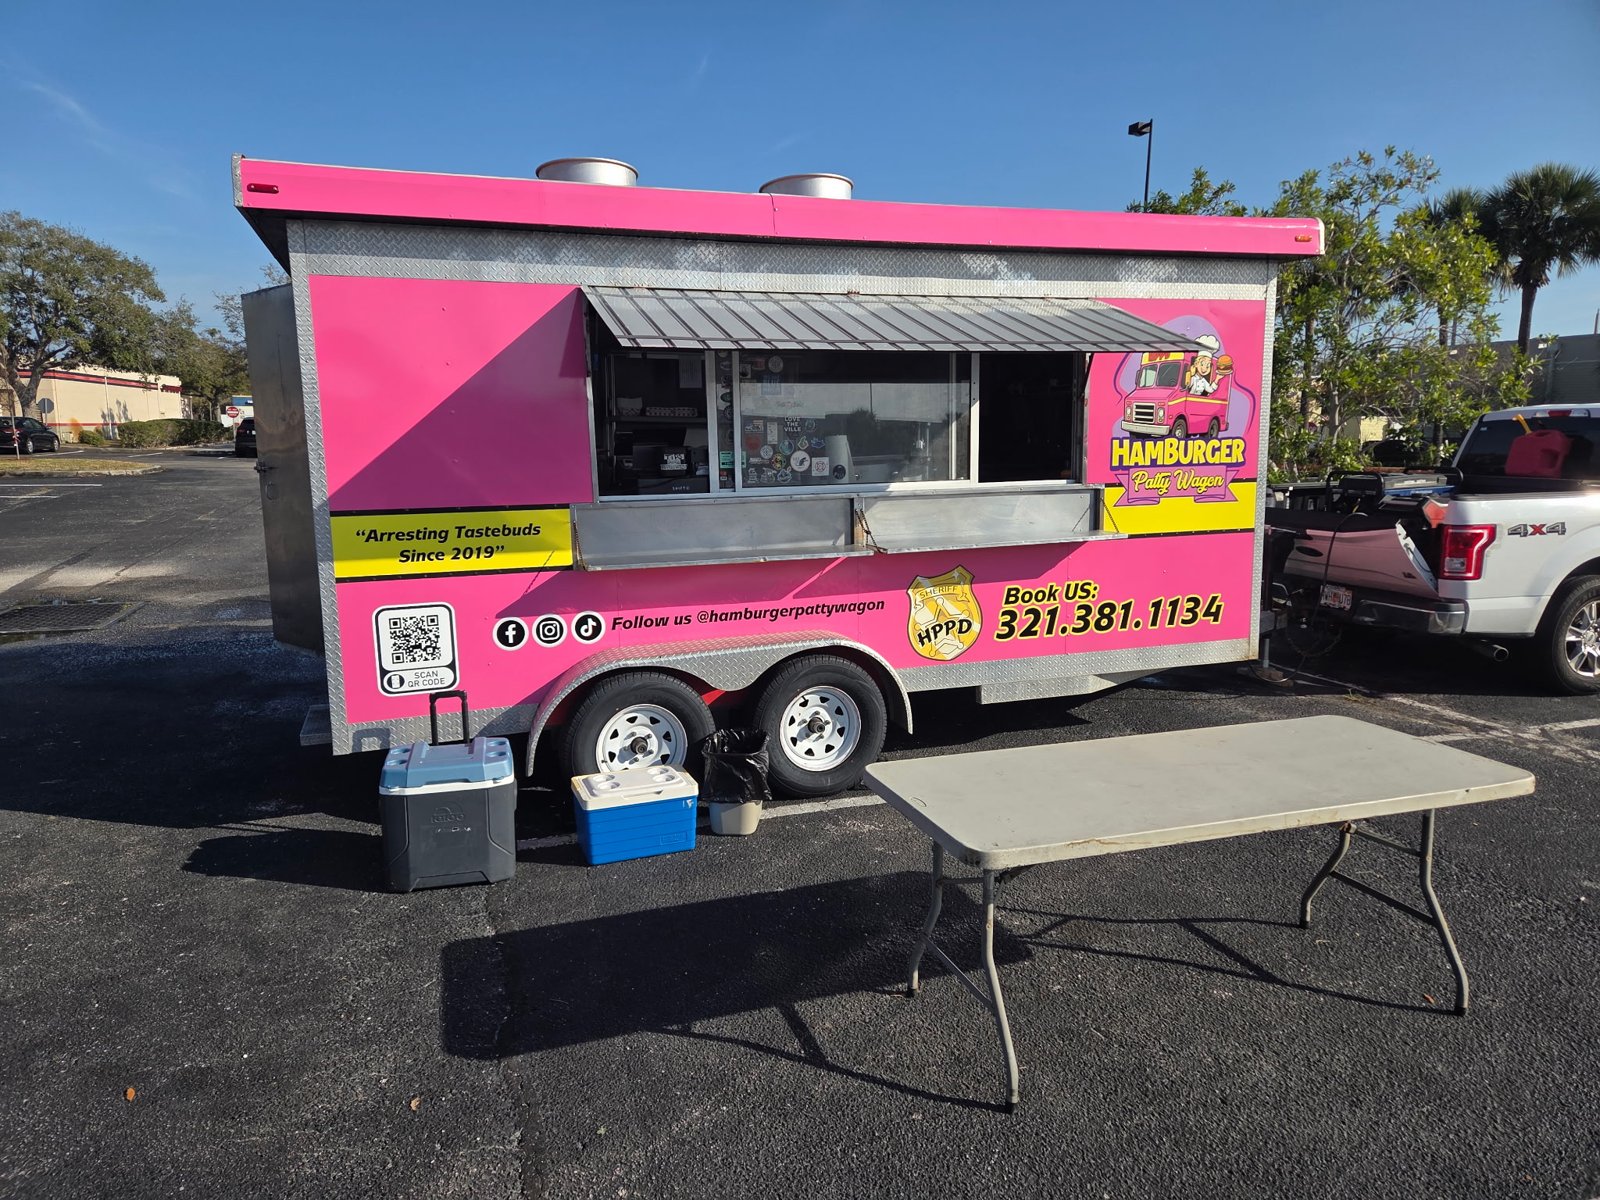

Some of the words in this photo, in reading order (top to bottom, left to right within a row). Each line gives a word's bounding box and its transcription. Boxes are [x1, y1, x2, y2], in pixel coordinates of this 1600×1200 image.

[1111, 437, 1245, 466] HAMBURGER
[1132, 470, 1172, 495] Patty
[454, 523, 541, 540] Tastebuds
[398, 548, 445, 563] Since
[919, 585, 958, 599] SHERIFF
[1004, 584, 1058, 606] Book
[1064, 582, 1099, 602] US:
[611, 615, 670, 631] Follow
[674, 613, 692, 626] us
[696, 600, 885, 623] @hamburgerpattywagon
[994, 594, 1224, 640] 321.381.1134
[917, 618, 973, 647] HPPD
[407, 680, 420, 688] QR
[422, 677, 446, 687] CODE
[414, 670, 439, 680] SCAN
